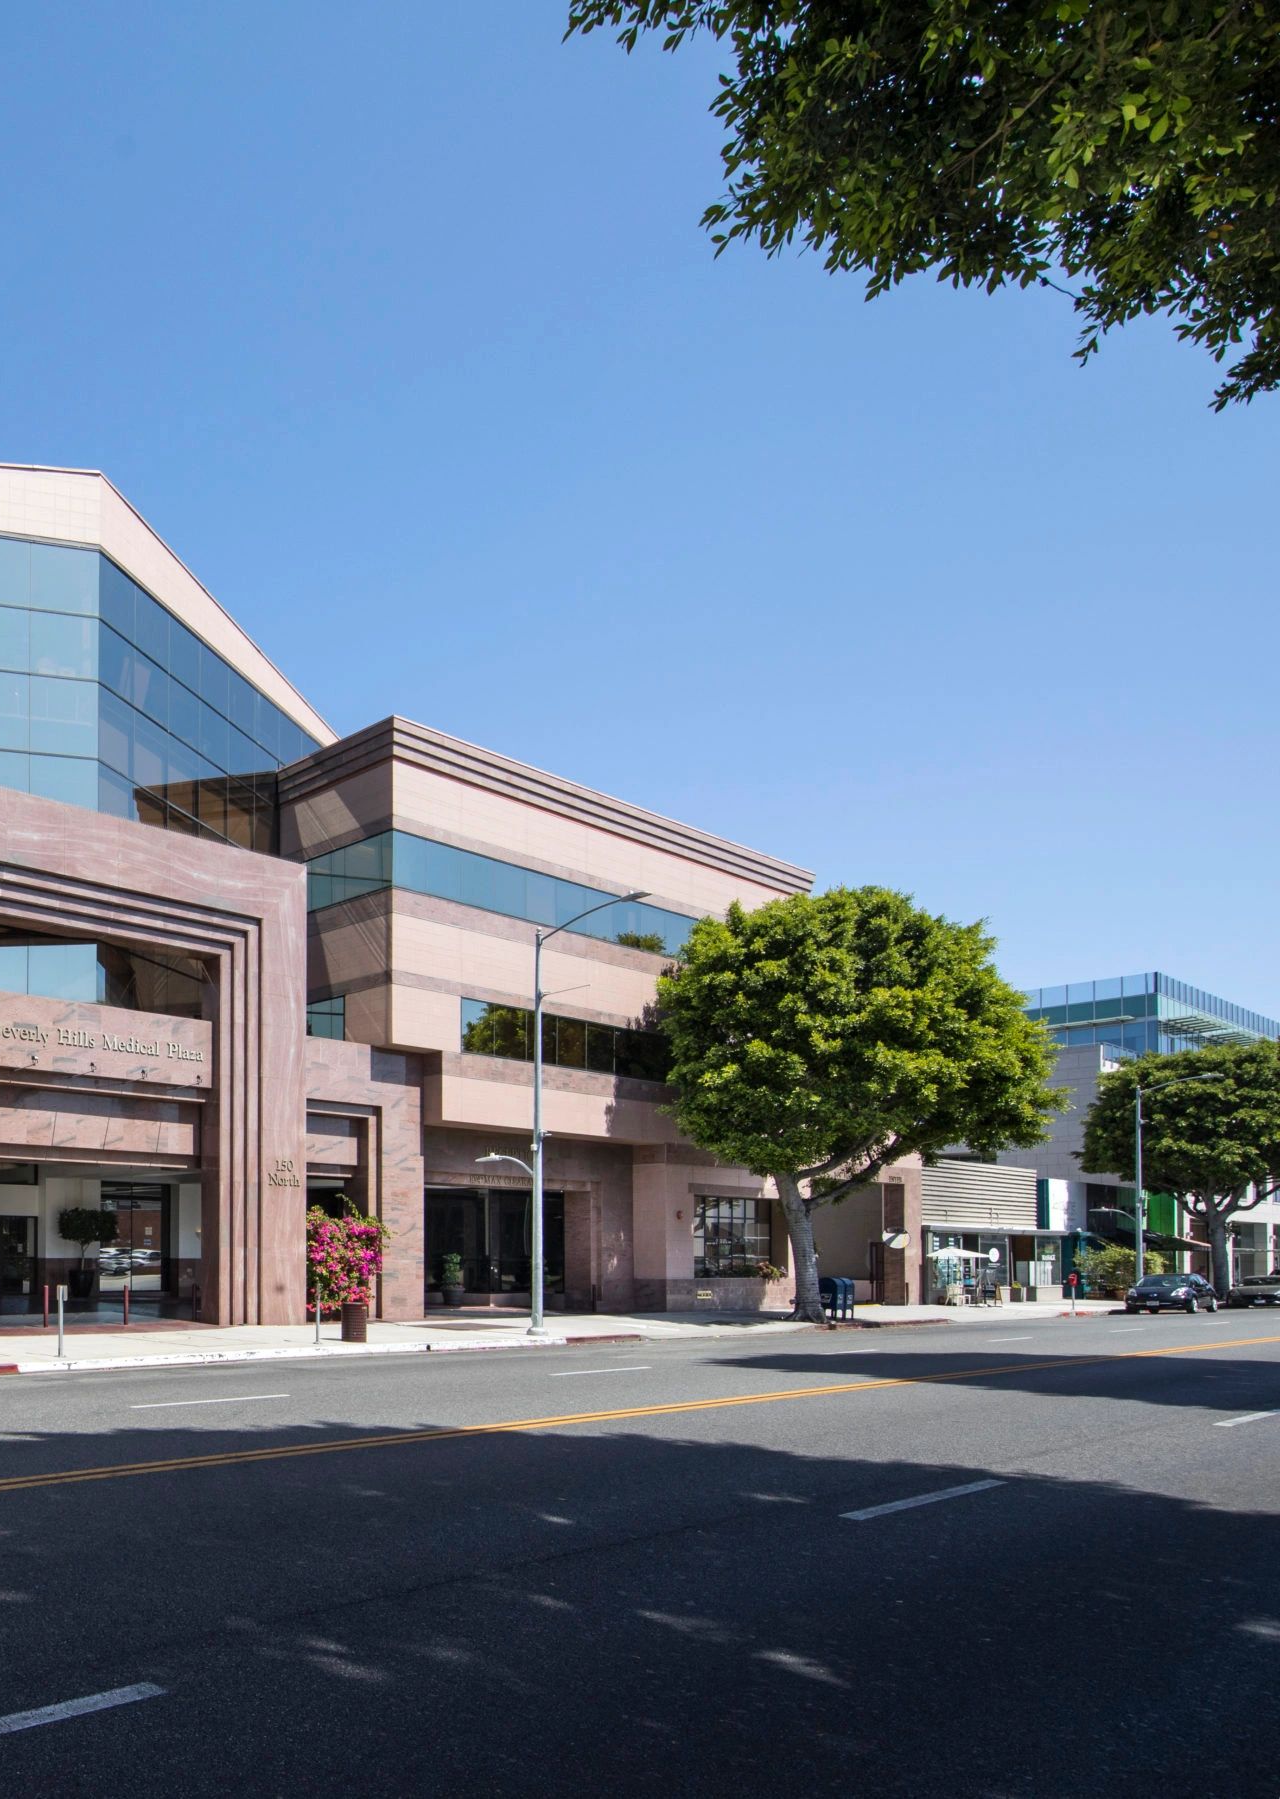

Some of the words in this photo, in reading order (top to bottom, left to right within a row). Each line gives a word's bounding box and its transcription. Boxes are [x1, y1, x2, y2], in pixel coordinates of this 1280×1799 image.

[57, 1028, 95, 1048] Hills
[102, 1034, 160, 1057] Medical
[167, 1042, 203, 1062] Plaza
[275, 1160, 294, 1172] 150
[268, 1173, 300, 1187] North
